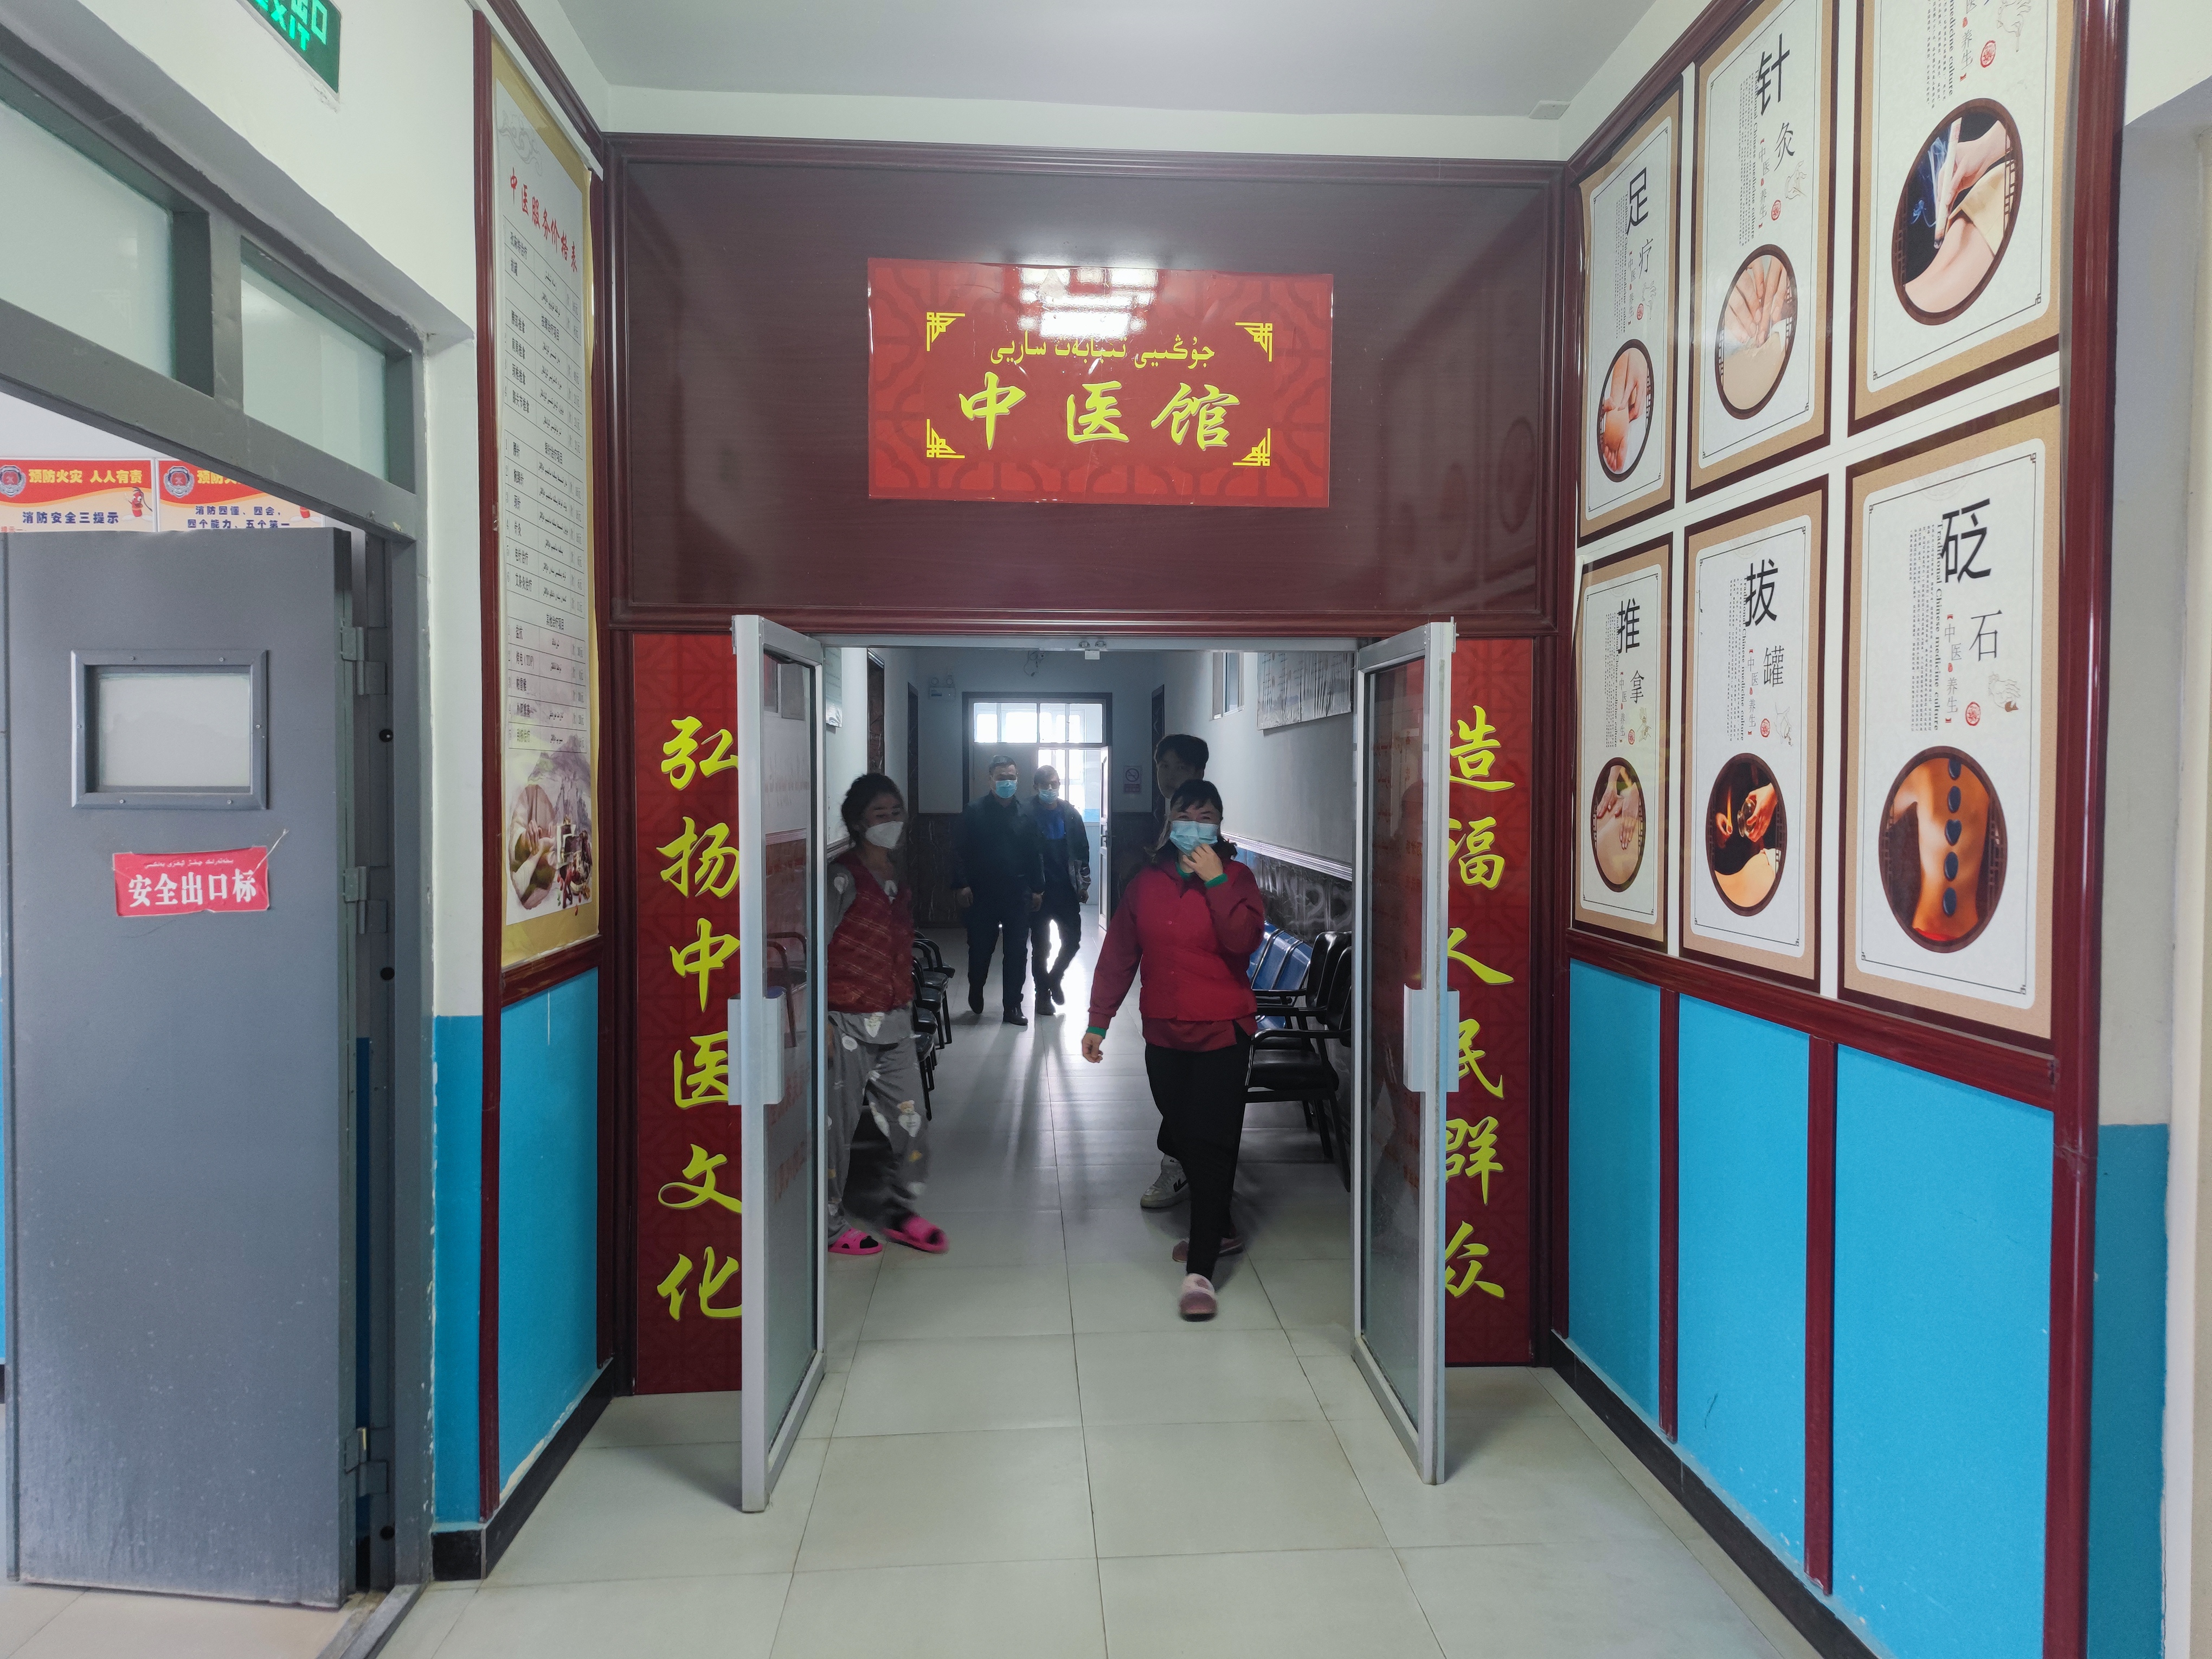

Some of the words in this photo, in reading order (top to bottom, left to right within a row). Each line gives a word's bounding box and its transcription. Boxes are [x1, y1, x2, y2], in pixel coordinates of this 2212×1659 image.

[255, 0, 310, 52] XIT
[1756, 33, 1796, 172] 针灸
[1626, 166, 1654, 279] 足疗
[958, 371, 1240, 452] 中医馆
[22, 511, 119, 524] 消防安全三提示
[29, 469, 83, 484] 预防火灾
[89, 469, 142, 484] 人人有责
[197, 470, 243, 484] 预防
[1745, 558, 1785, 687] 拔罐
[1940, 498, 2003, 662] 砭石
[1616, 597, 1645, 704] 推拿
[1747, 656, 1759, 727] 中医养生
[1945, 623, 1962, 713] 中医养生
[128, 868, 257, 907] 安全出口标
[656, 716, 742, 1321] 弘扬中医文化
[1444, 705, 1515, 1299] 造福人民群众
